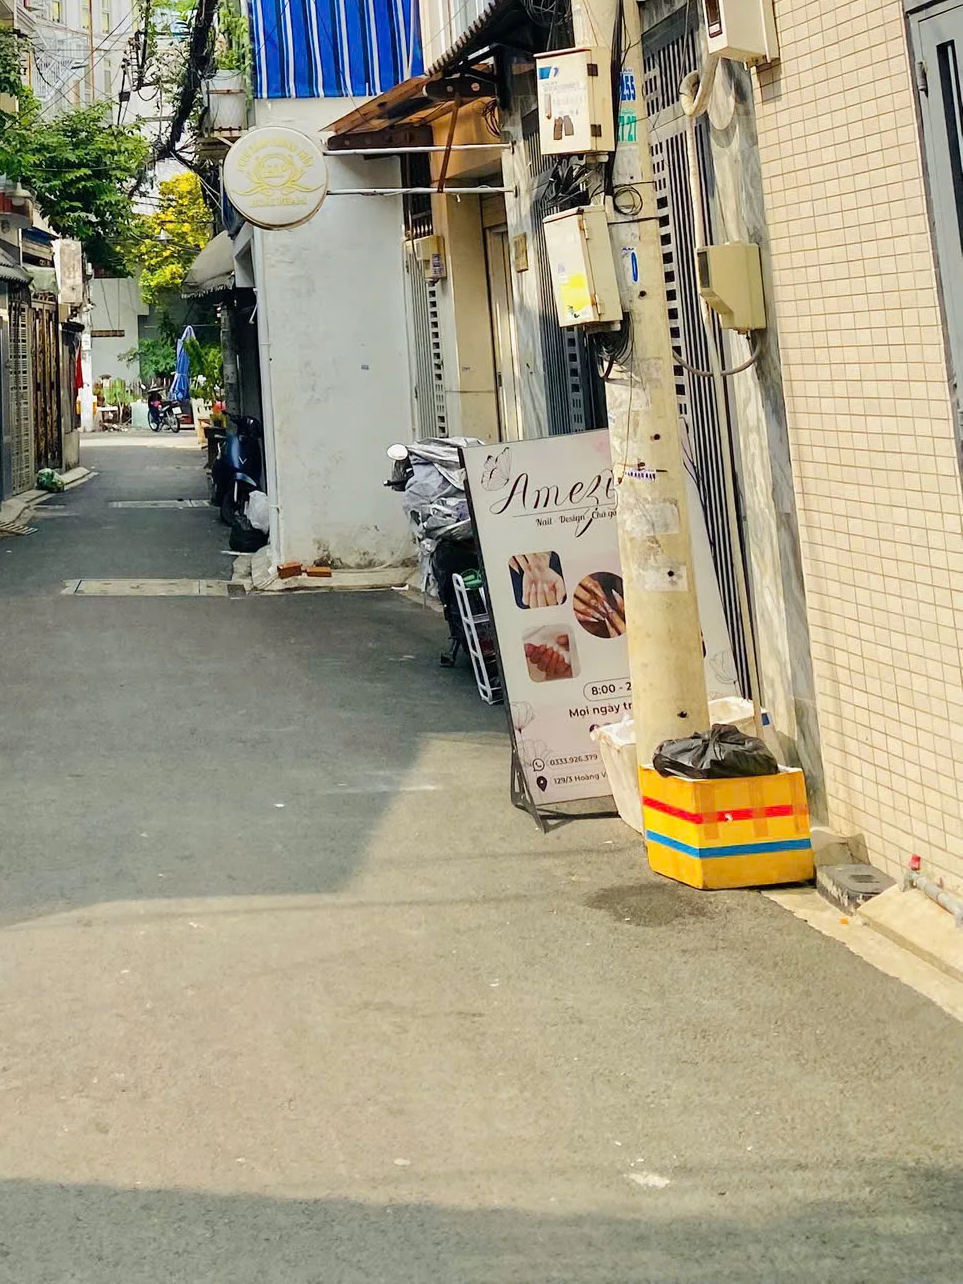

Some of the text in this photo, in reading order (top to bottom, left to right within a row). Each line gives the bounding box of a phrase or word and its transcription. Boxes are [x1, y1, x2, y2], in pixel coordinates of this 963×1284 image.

[536, 517, 553, 527] Nail
[559, 513, 586, 524] Design
[591, 683, 616, 696] 8:00
[553, 775, 573, 786] 129/3
